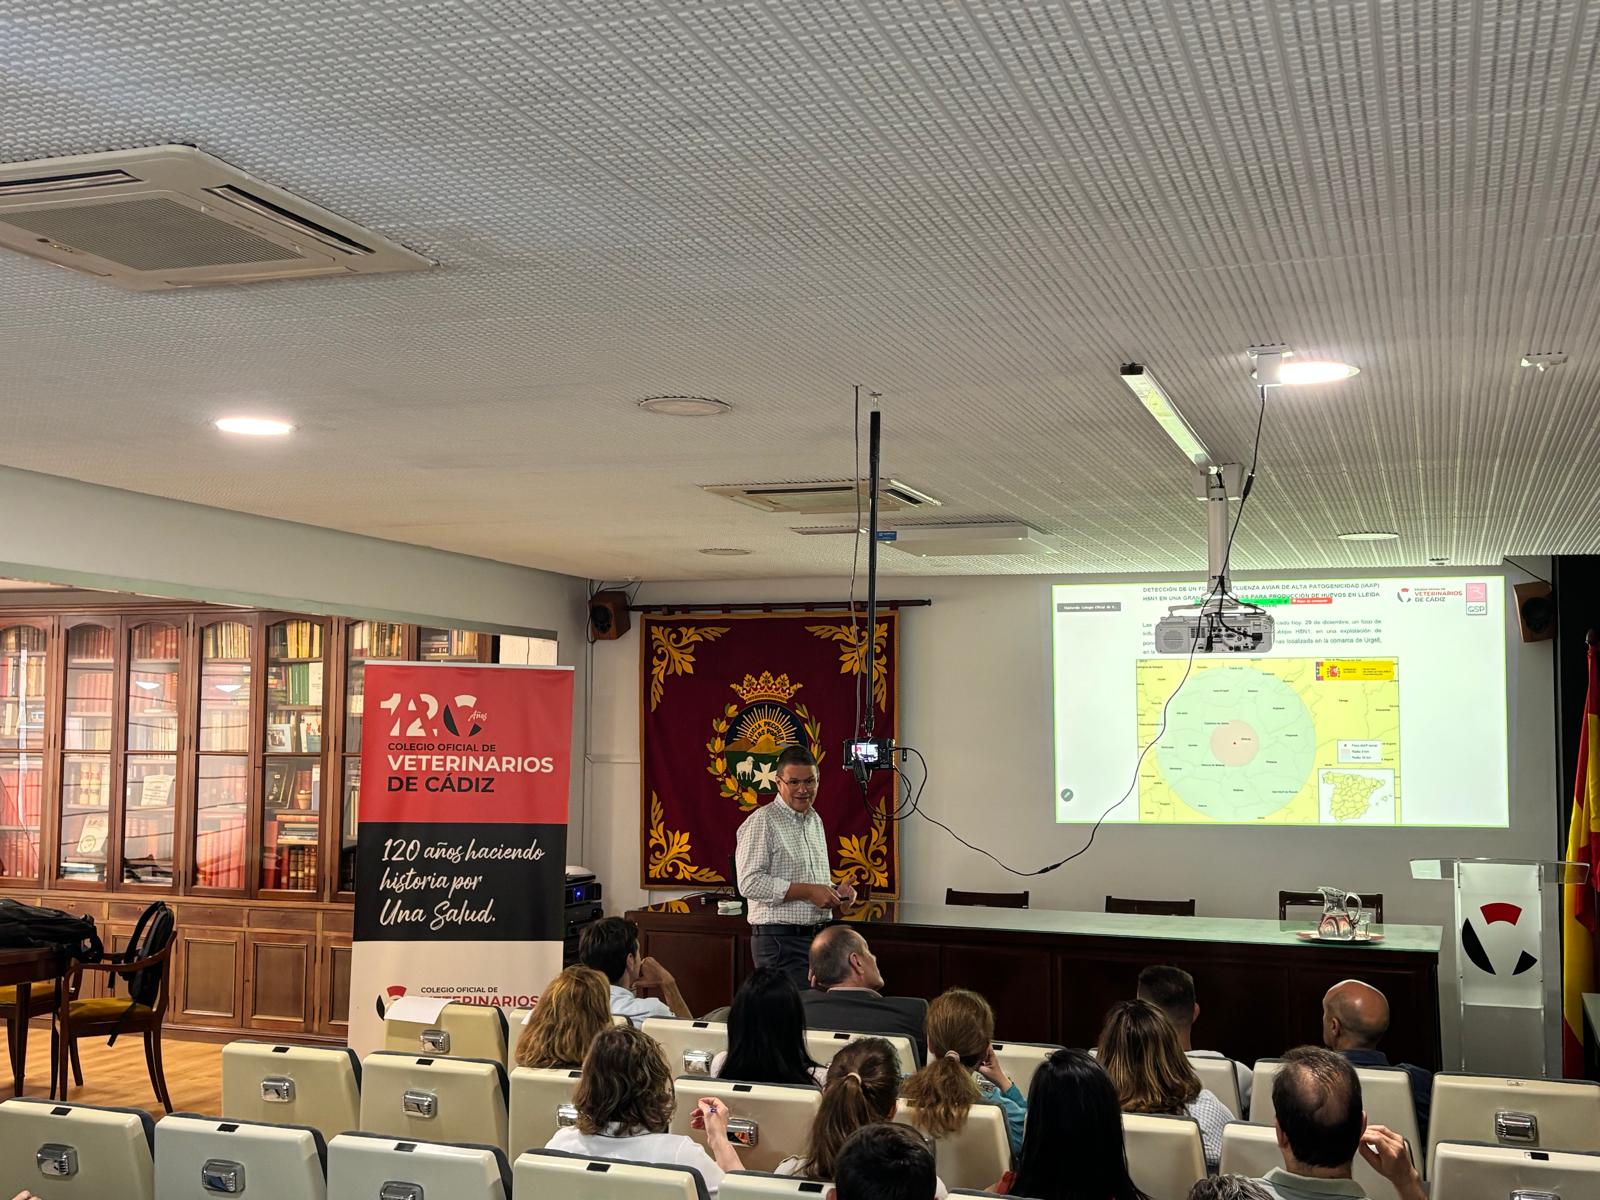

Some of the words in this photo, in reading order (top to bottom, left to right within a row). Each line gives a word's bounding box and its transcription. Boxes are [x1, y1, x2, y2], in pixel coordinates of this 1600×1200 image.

[388, 742, 435, 751] COLEGIO
[438, 743, 479, 752] OFICIAL
[482, 744, 496, 752] DE
[387, 754, 554, 773] VETERINARIOS
[387, 776, 418, 792] DE
[424, 773, 495, 793] CÁDIZ
[381, 838, 421, 862] 120
[424, 842, 464, 863] años
[464, 838, 545, 861] haciendo
[379, 867, 450, 893] historia
[448, 874, 482, 898] por
[380, 898, 426, 926] Una
[430, 898, 496, 931] Salud.
